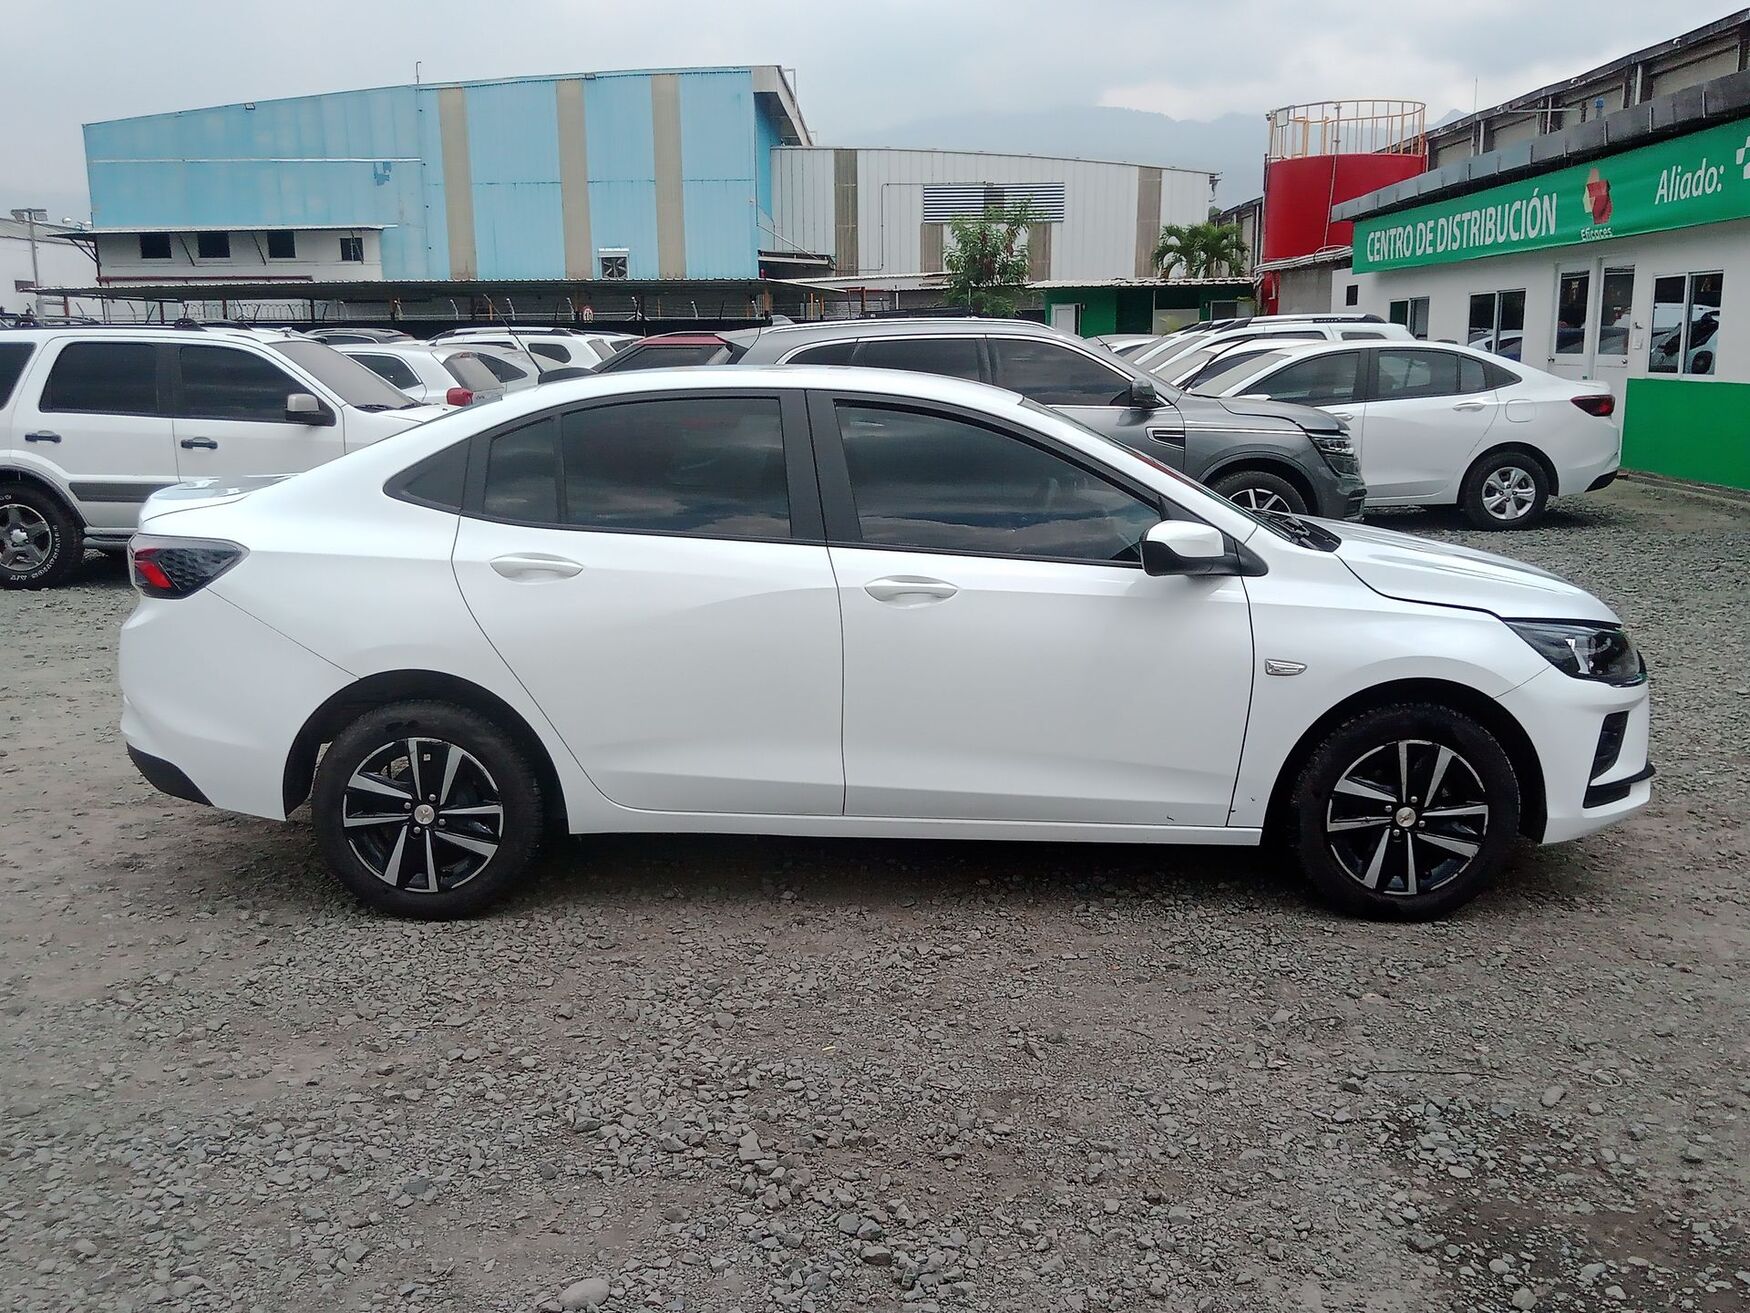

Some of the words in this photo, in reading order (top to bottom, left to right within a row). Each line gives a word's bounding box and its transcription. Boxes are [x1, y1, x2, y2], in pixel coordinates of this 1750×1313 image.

[1654, 157, 1725, 205] Aliado:
[1366, 223, 1414, 263] CENTRO
[1415, 219, 1435, 257] DE
[1436, 187, 1557, 253] DISTRIBUCIÓN
